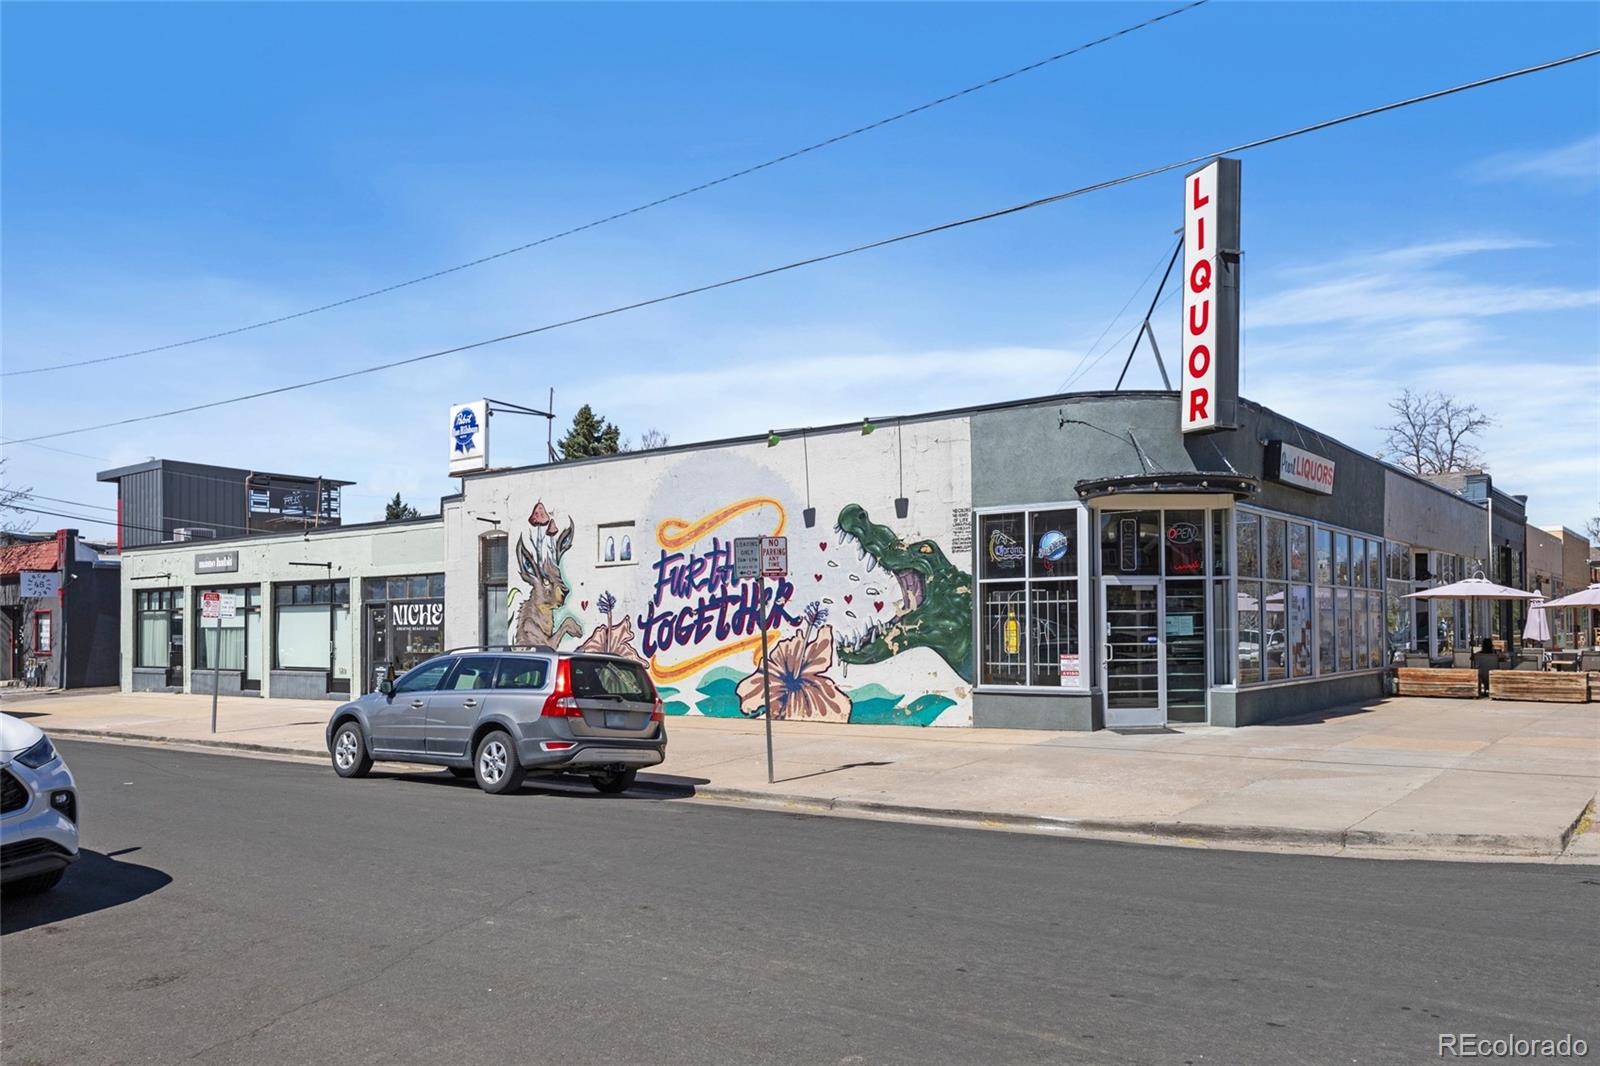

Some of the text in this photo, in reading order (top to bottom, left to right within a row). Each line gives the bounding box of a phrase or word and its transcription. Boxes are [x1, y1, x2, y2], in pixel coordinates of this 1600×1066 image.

[1188, 177, 1212, 423] LIQUOR
[1296, 455, 1333, 486] LIQUORS
[1167, 528, 1196, 539] OPEN
[762, 548, 786, 556] PARKING
[995, 545, 1025, 556] Corona
[392, 603, 443, 626] NICHE
